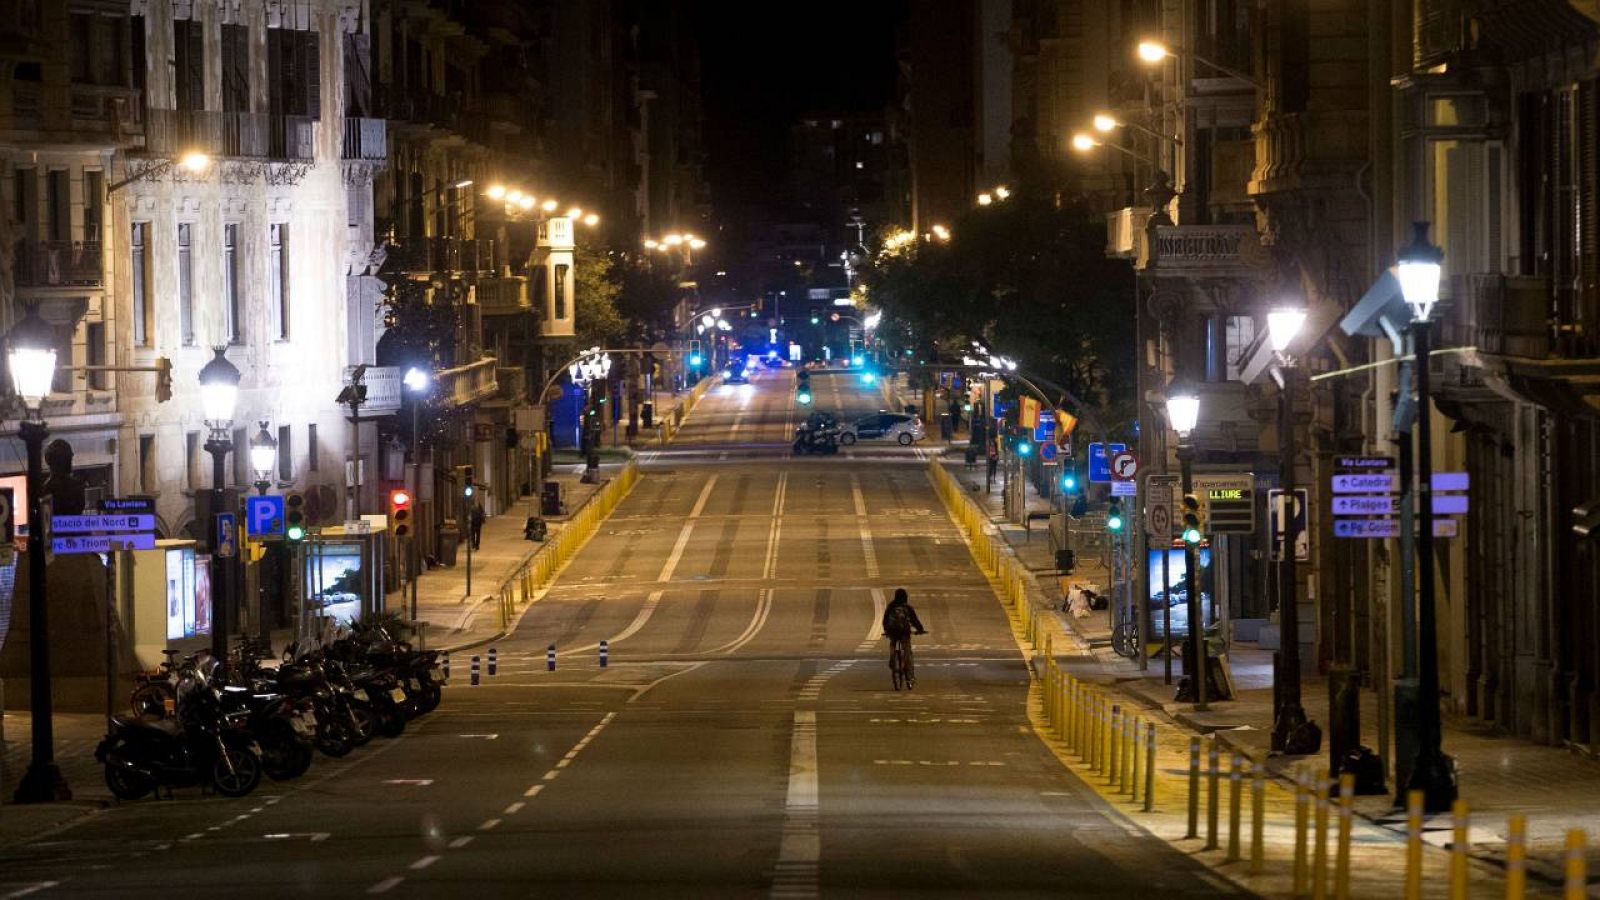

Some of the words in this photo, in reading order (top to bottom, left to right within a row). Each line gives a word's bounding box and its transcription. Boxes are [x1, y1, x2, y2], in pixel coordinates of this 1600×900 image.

[1350, 477, 1392, 487] Catedral
[1209, 490, 1242, 499] LLIURE
[104, 500, 116, 509] Via
[1350, 499, 1388, 510] Platges
[255, 500, 276, 534] P
[53, 518, 82, 528] stació
[84, 518, 99, 527] del
[102, 517, 126, 527] Nord
